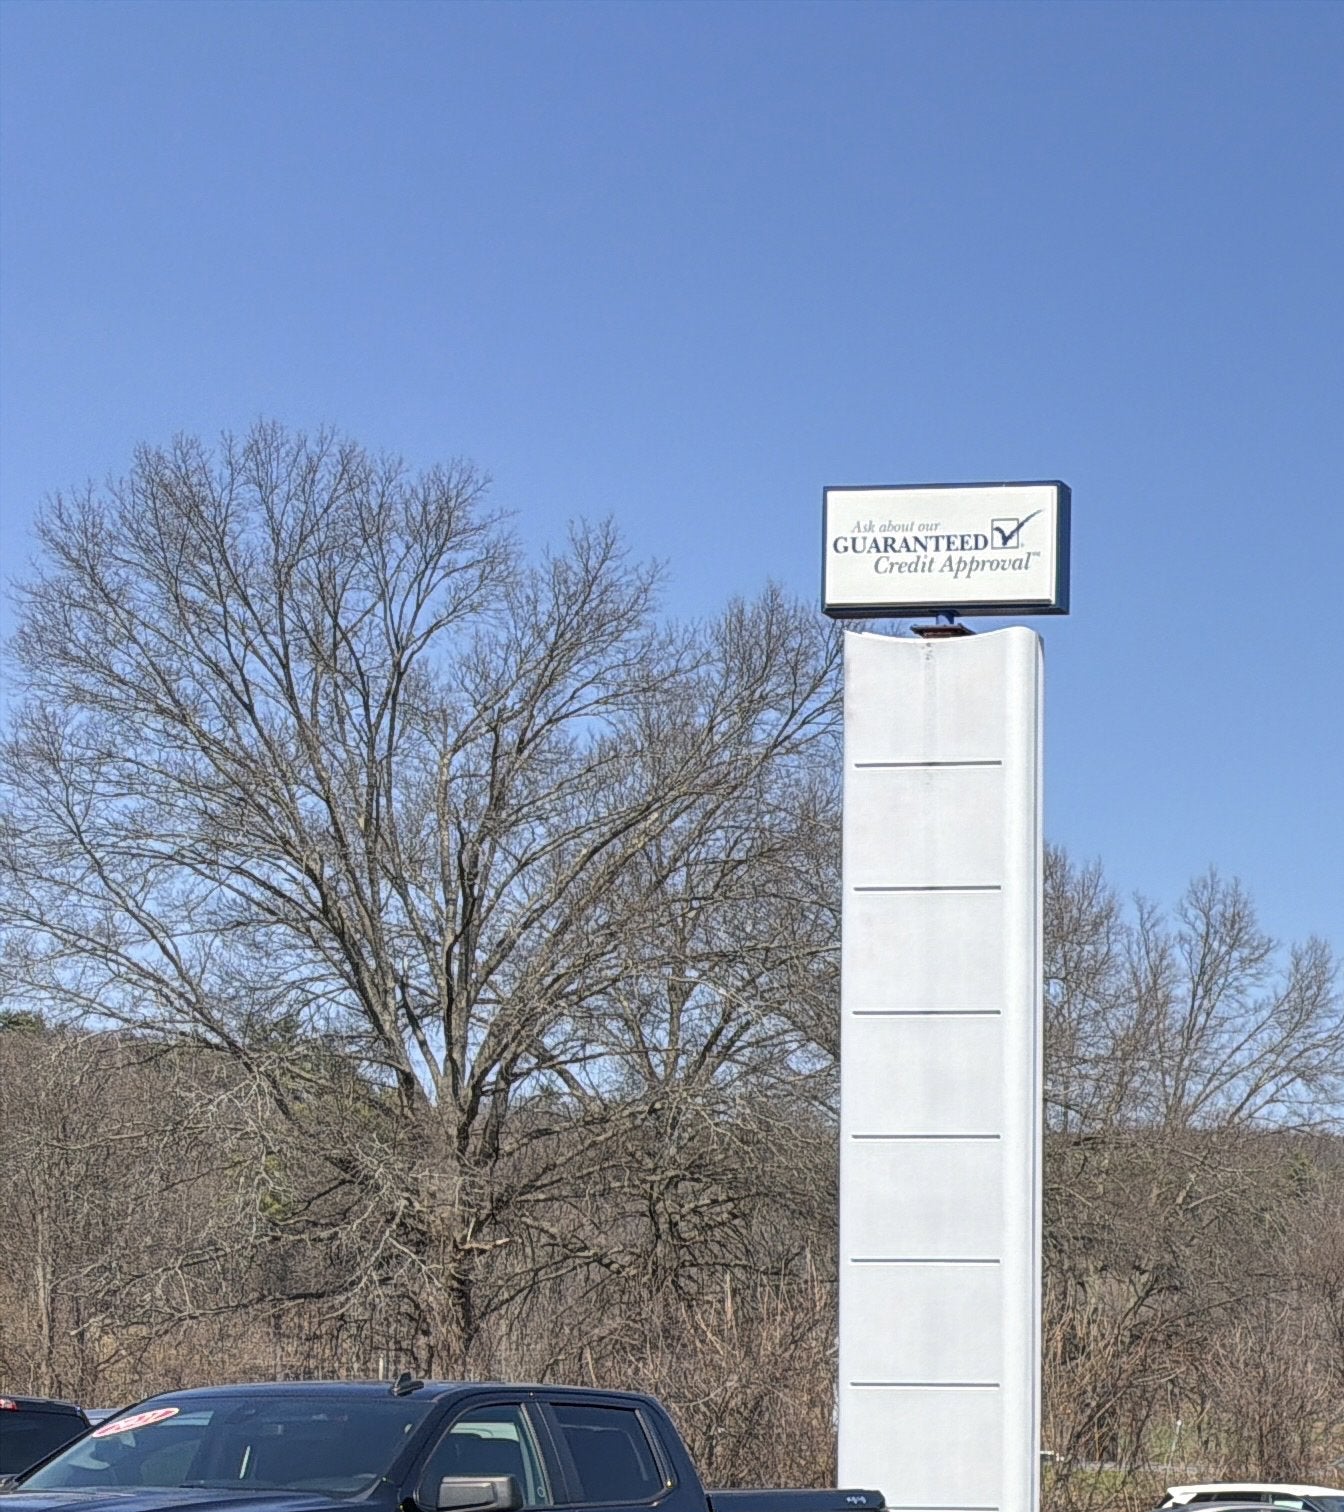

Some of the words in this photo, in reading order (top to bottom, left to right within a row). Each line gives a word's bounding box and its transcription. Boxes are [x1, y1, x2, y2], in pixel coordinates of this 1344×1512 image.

[851, 520, 876, 534] Ask
[879, 520, 915, 533] about
[918, 522, 941, 532] our
[833, 533, 988, 554] GUARANTEED
[874, 554, 935, 574] Credit
[938, 551, 1032, 579] Approval
